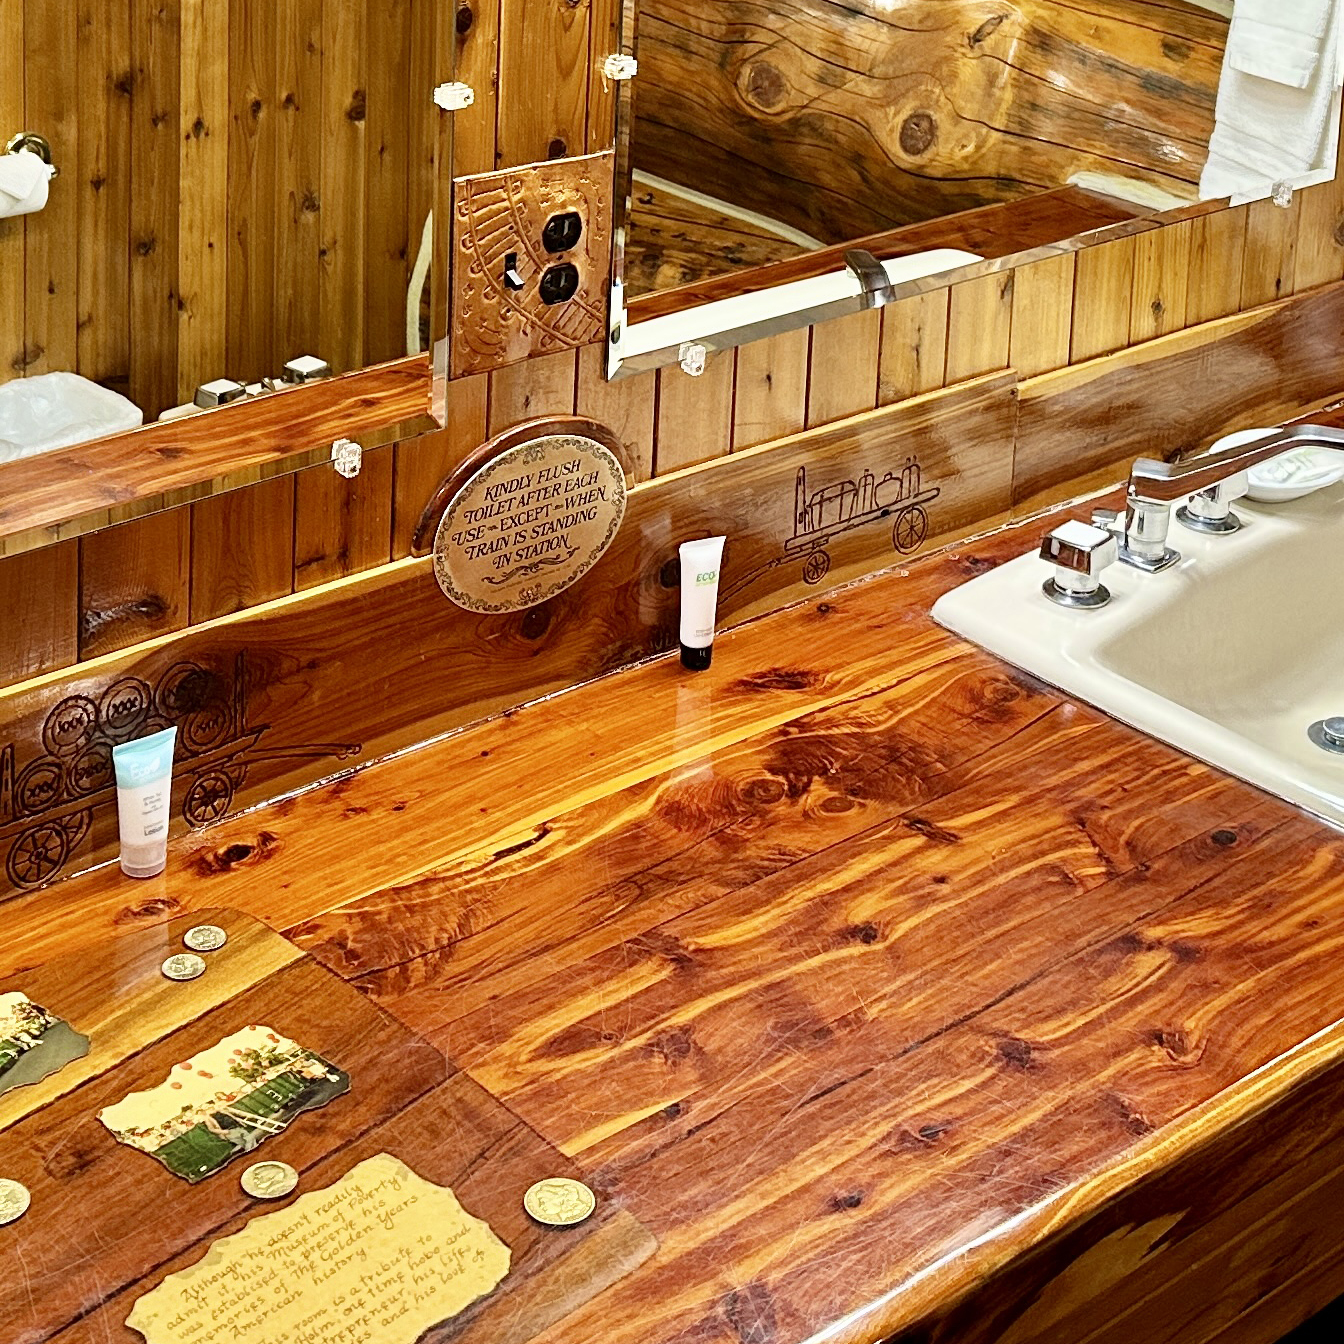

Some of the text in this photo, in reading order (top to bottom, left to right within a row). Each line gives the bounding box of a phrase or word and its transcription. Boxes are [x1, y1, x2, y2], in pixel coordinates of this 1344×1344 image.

[464, 471, 599, 524] TOILET AFTER EACH
[484, 459, 581, 502] KINDLY FLUSH
[452, 485, 609, 546] USE EXCEPT WHEN
[465, 506, 597, 560] TRAIN IS STANDING
[493, 533, 572, 569] IN STATION
[167, 1296, 208, 1330] admit
[240, 1265, 263, 1281] his
[266, 1223, 330, 1261] Museum
[332, 1208, 346, 1223] of
[348, 1176, 401, 1210] Poverty
[178, 1321, 203, 1339] was
[282, 1259, 296, 1269] to
[301, 1220, 356, 1261] preserve
[362, 1200, 385, 1217] his
[180, 1260, 243, 1303] Although
[243, 1246, 264, 1260] he
[314, 1185, 364, 1216] readily
[274, 1278, 288, 1294] of
[320, 1225, 374, 1261] Golden
[376, 1195, 418, 1230] Years
[343, 1298, 366, 1316] one
[367, 1272, 404, 1298] time
[408, 1246, 440, 1270] hobo
[446, 1223, 471, 1245] and
[293, 1308, 327, 1331] room
[333, 1296, 346, 1307] is
[360, 1247, 413, 1287] tribute
[417, 1235, 432, 1245] to
[381, 1301, 409, 1326] and
[414, 1286, 436, 1304] his
[437, 1264, 465, 1284] love
[412, 1268, 435, 1285] his
[229, 1290, 303, 1340] American
